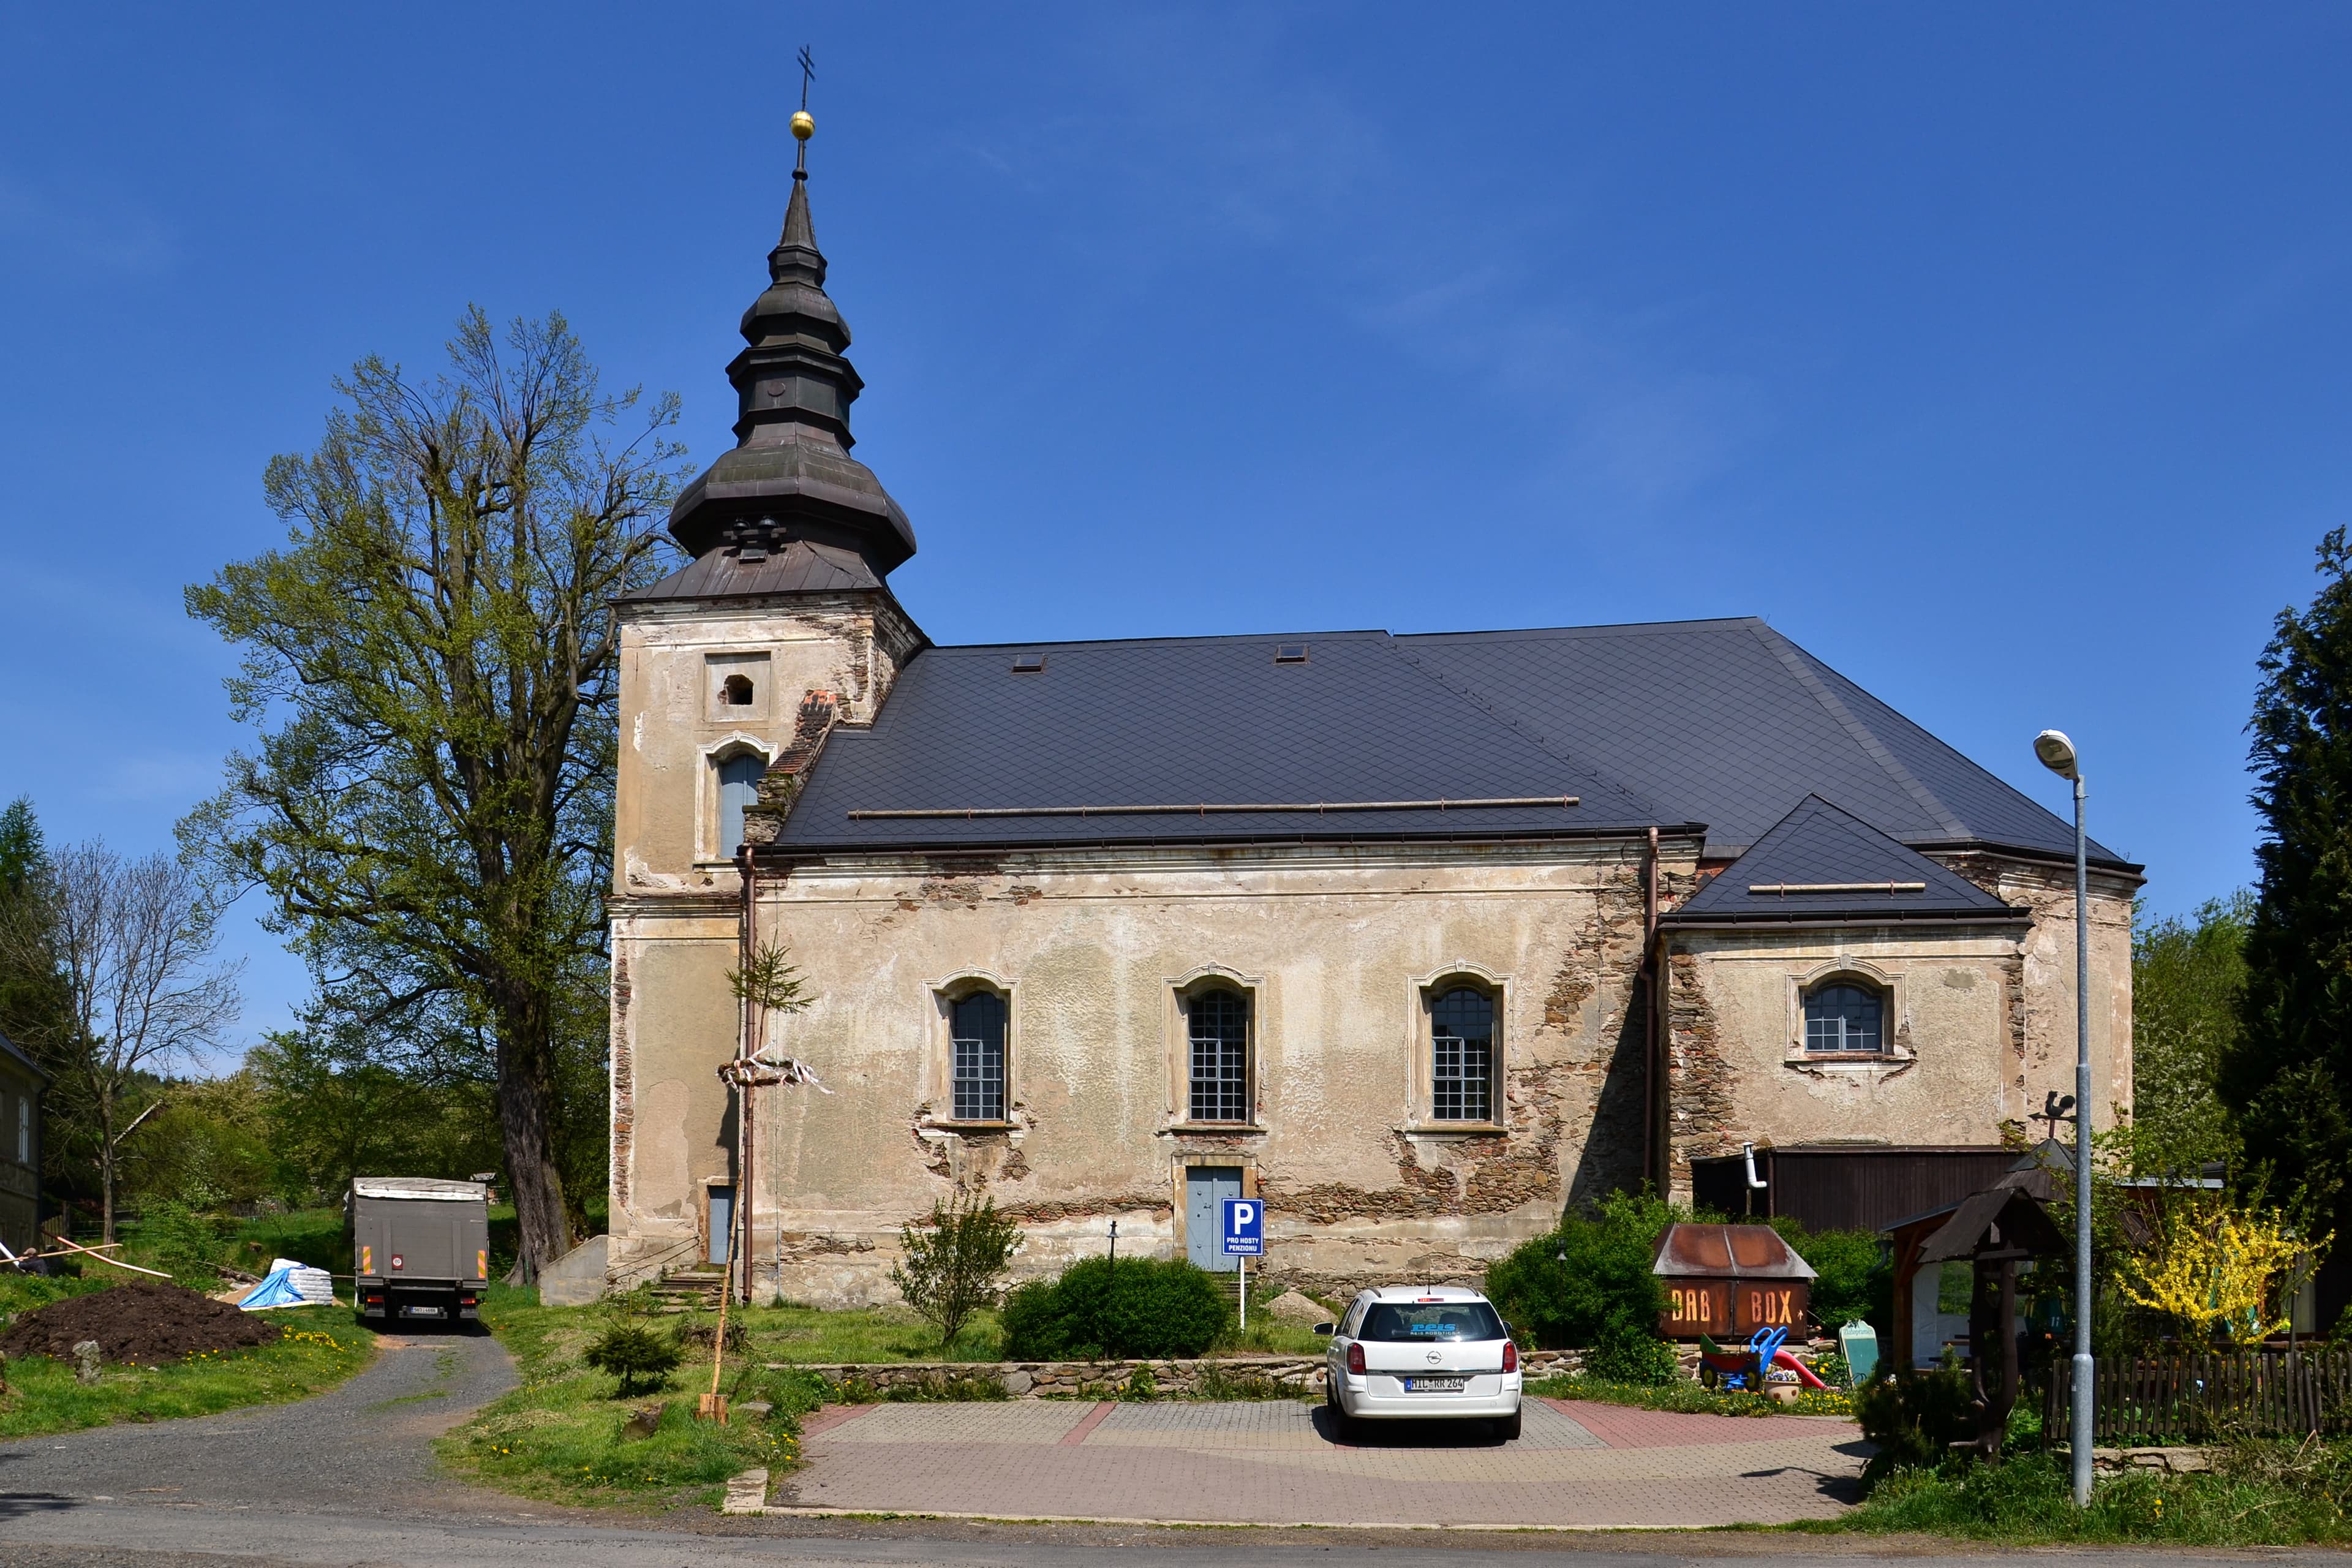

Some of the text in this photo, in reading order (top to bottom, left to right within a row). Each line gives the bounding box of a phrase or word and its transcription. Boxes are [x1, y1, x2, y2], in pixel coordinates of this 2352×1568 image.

[1234, 1203, 1254, 1235] P
[1751, 1290, 1792, 1324] BOX
[1411, 1378, 1463, 1389] HIL RR 264
